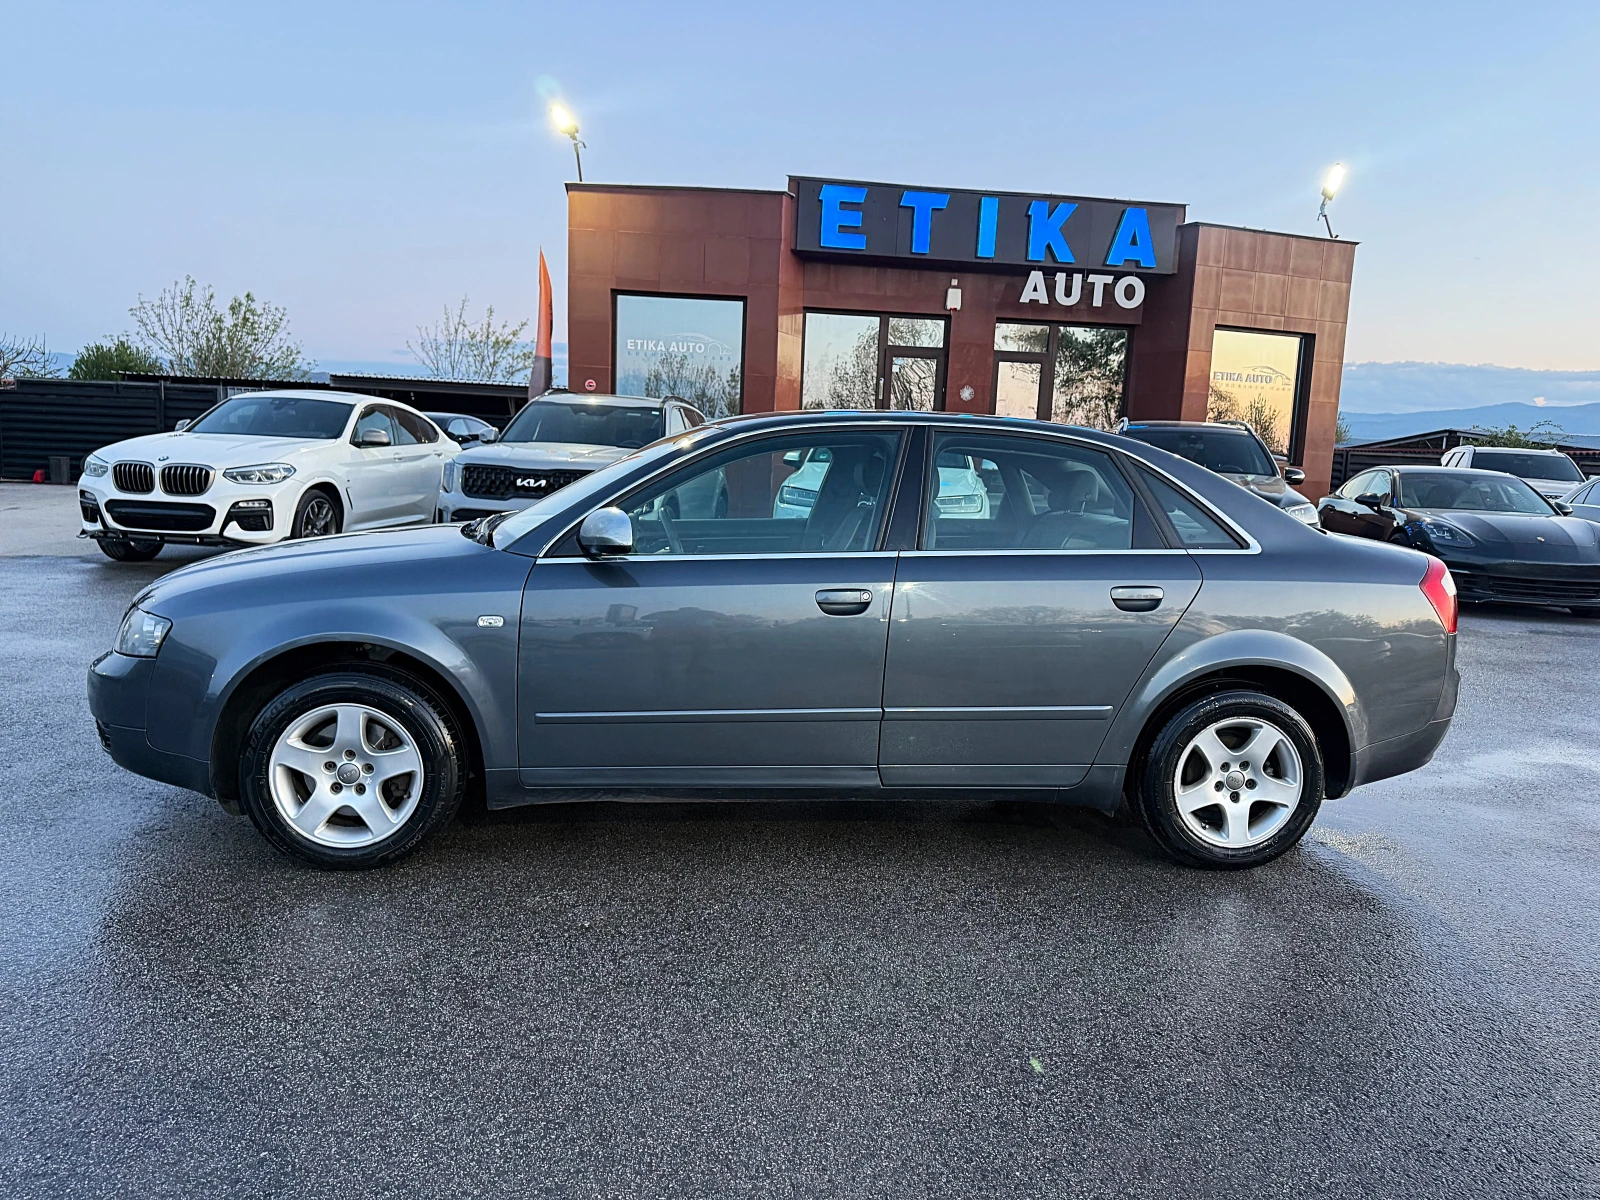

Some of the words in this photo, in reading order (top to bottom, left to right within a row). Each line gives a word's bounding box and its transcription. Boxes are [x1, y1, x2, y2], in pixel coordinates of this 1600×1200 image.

[819, 184, 1157, 268] ETIKA
[1019, 270, 1145, 309] AUTO
[627, 339, 666, 352] ETIKA
[669, 342, 705, 354] AUTO
[1213, 371, 1243, 382] ETIKA
[1244, 373, 1273, 384] AUTO
